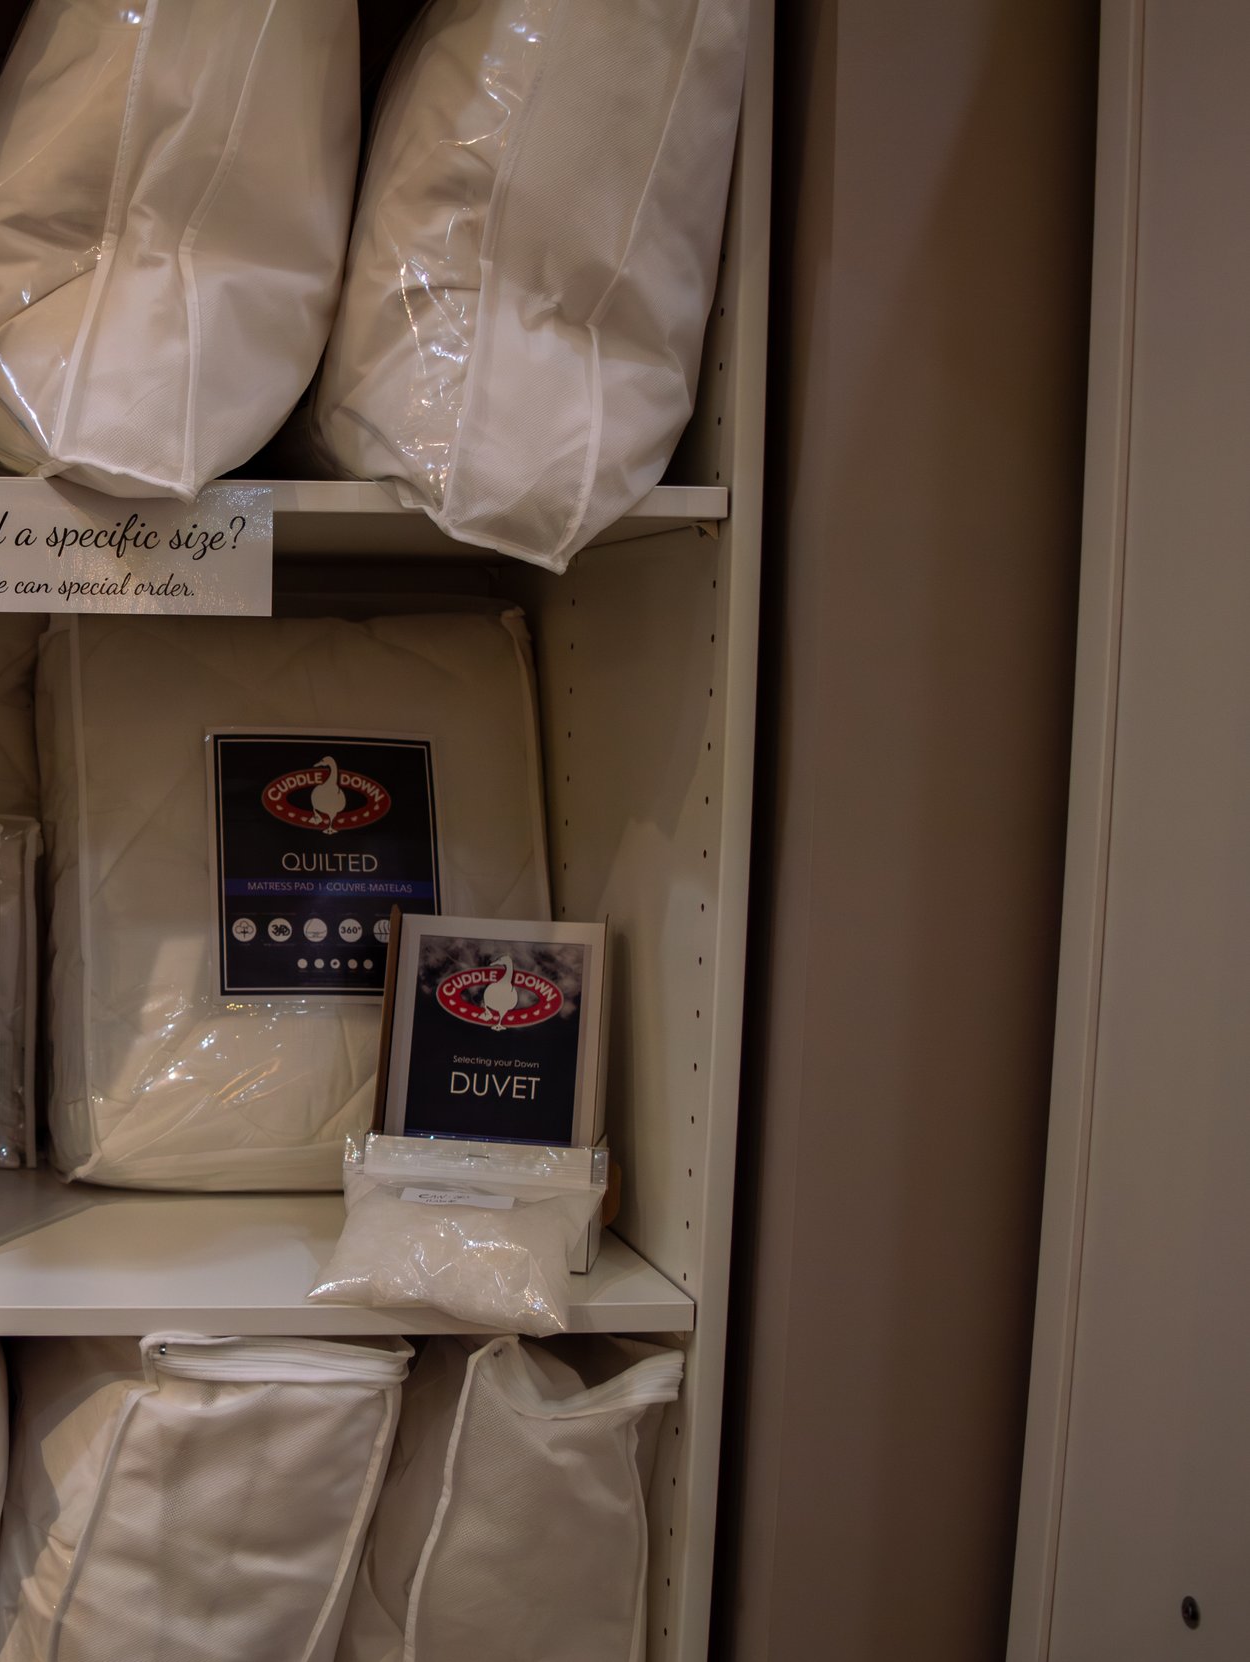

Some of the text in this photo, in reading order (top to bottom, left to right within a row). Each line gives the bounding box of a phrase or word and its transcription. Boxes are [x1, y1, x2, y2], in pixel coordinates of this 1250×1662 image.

[14, 526, 37, 546] a
[46, 513, 160, 558] specific
[169, 516, 247, 560] size?
[14, 580, 53, 594] can
[58, 573, 132, 601] special
[134, 573, 195, 597] order.
[268, 772, 385, 802] CUDDLE DOWN
[281, 852, 378, 873] QUILTED
[247, 881, 292, 892] MATRESS
[294, 882, 314, 892] PAD
[442, 971, 557, 1002] CUDDLE DOWN
[453, 1055, 540, 1069] Selecting your Down
[450, 1071, 541, 1100] DUVET
